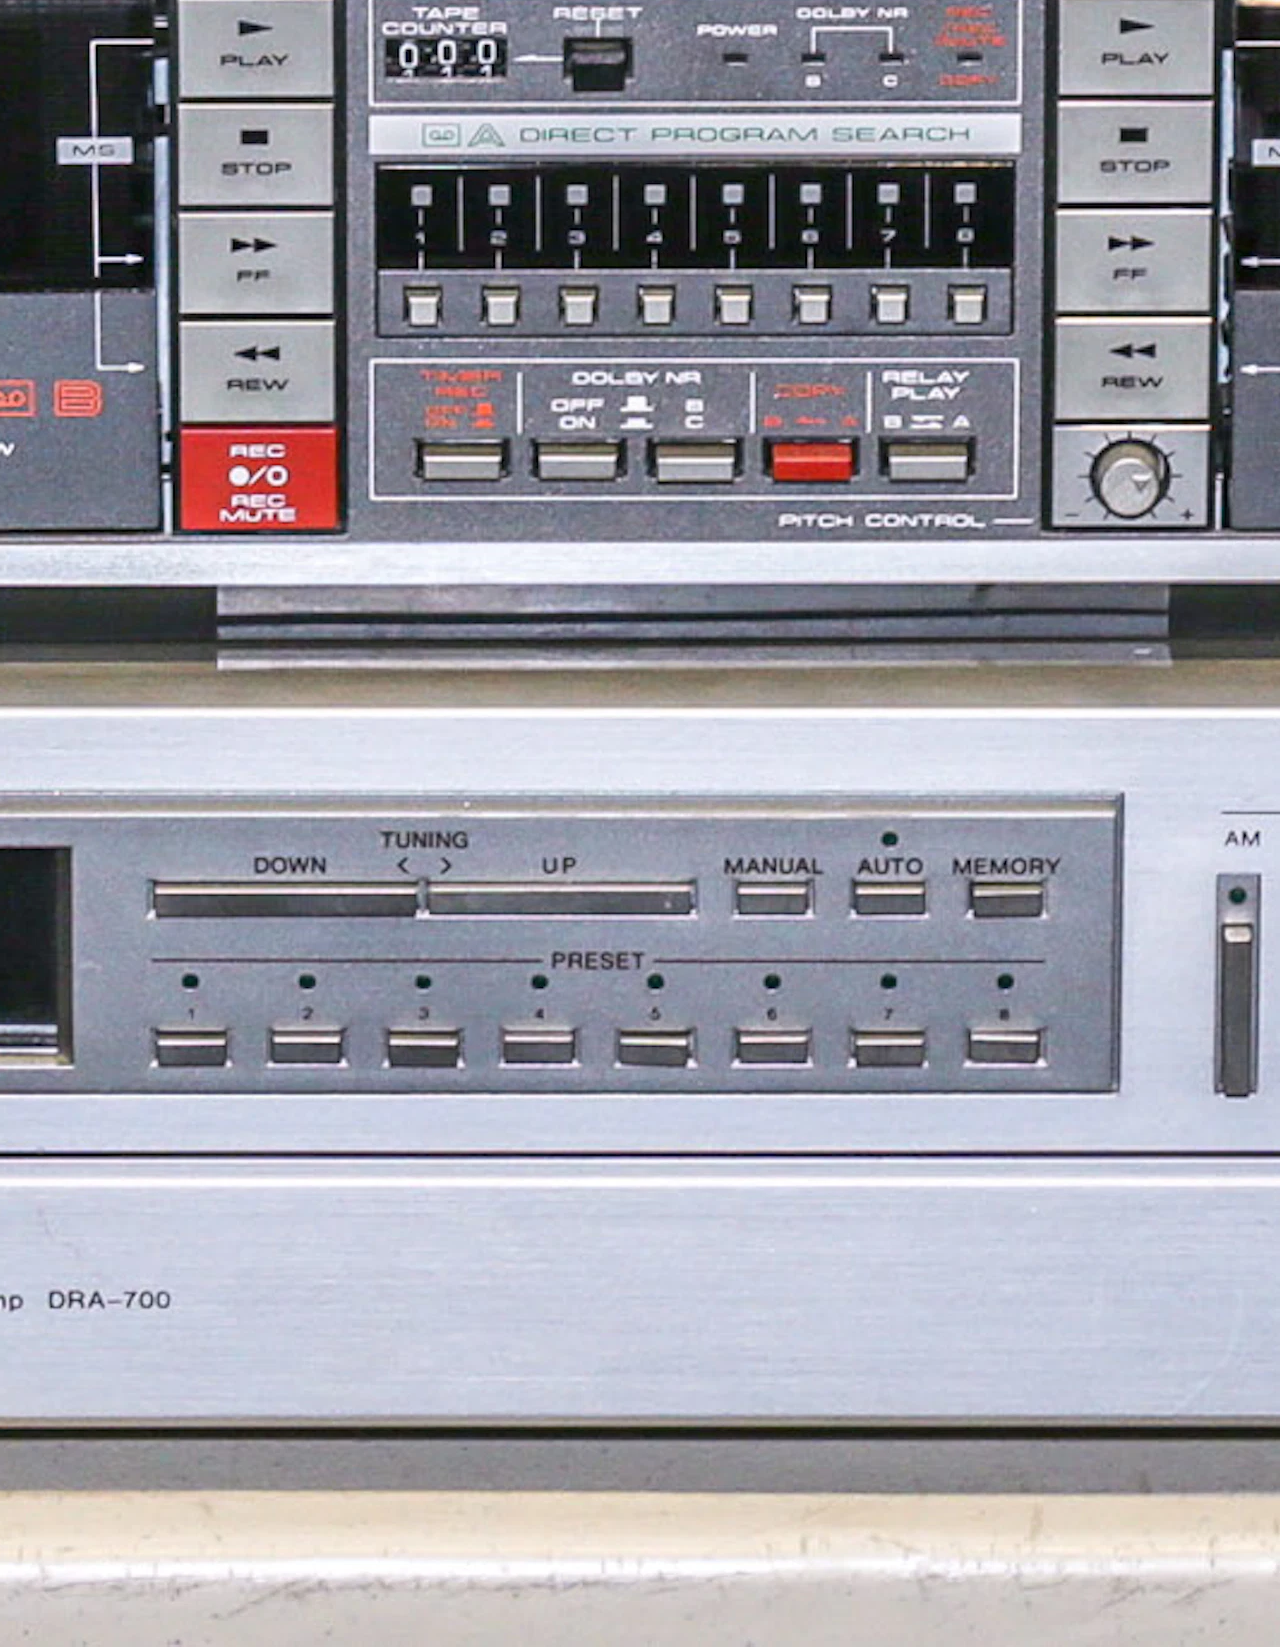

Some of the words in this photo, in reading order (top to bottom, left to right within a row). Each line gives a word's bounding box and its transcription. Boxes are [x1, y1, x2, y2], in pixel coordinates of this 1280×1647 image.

[411, 6, 480, 21] TAPE
[552, 7, 642, 20] RESET
[795, 6, 871, 20] DOLBY
[876, 7, 909, 19] NR
[382, 22, 508, 34] COUNTER
[696, 23, 778, 37] POWER
[220, 54, 288, 67] PLAY
[1101, 52, 1169, 66] PLAY
[882, 74, 898, 88] C
[519, 127, 638, 143] DIRECT
[650, 127, 818, 143] PROGRAM
[831, 127, 970, 143] SEARCH
[71, 143, 116, 157] MS
[221, 161, 292, 176] STOP
[1099, 159, 1171, 173] STOP
[236, 269, 270, 282] FF
[1112, 268, 1147, 280] FF
[226, 378, 289, 392] REW
[571, 370, 659, 386] DOLBY
[665, 370, 702, 385] NR
[882, 370, 970, 385] RELAY
[1101, 375, 1163, 389] REW
[891, 386, 960, 401] PLAY
[550, 398, 605, 413] OFF
[685, 398, 704, 413] B
[559, 415, 596, 430] ON
[684, 415, 704, 429] C
[883, 415, 902, 429] B
[952, 414, 970, 428] A
[229, 443, 286, 459] REC
[231, 495, 285, 507] REC
[220, 509, 296, 522] MUTE
[778, 513, 854, 528] PITCH
[864, 513, 987, 529] CONTROL
[379, 830, 469, 850] TUNING
[1224, 830, 1261, 847] AM
[253, 856, 327, 875] DOWN
[542, 856, 577, 875] UP
[723, 857, 824, 875] MANUAL
[857, 857, 924, 876] AUTO
[952, 857, 1061, 876] MEMORY
[551, 951, 645, 971] PRESET
[48, 1289, 171, 1310] DRA-700
